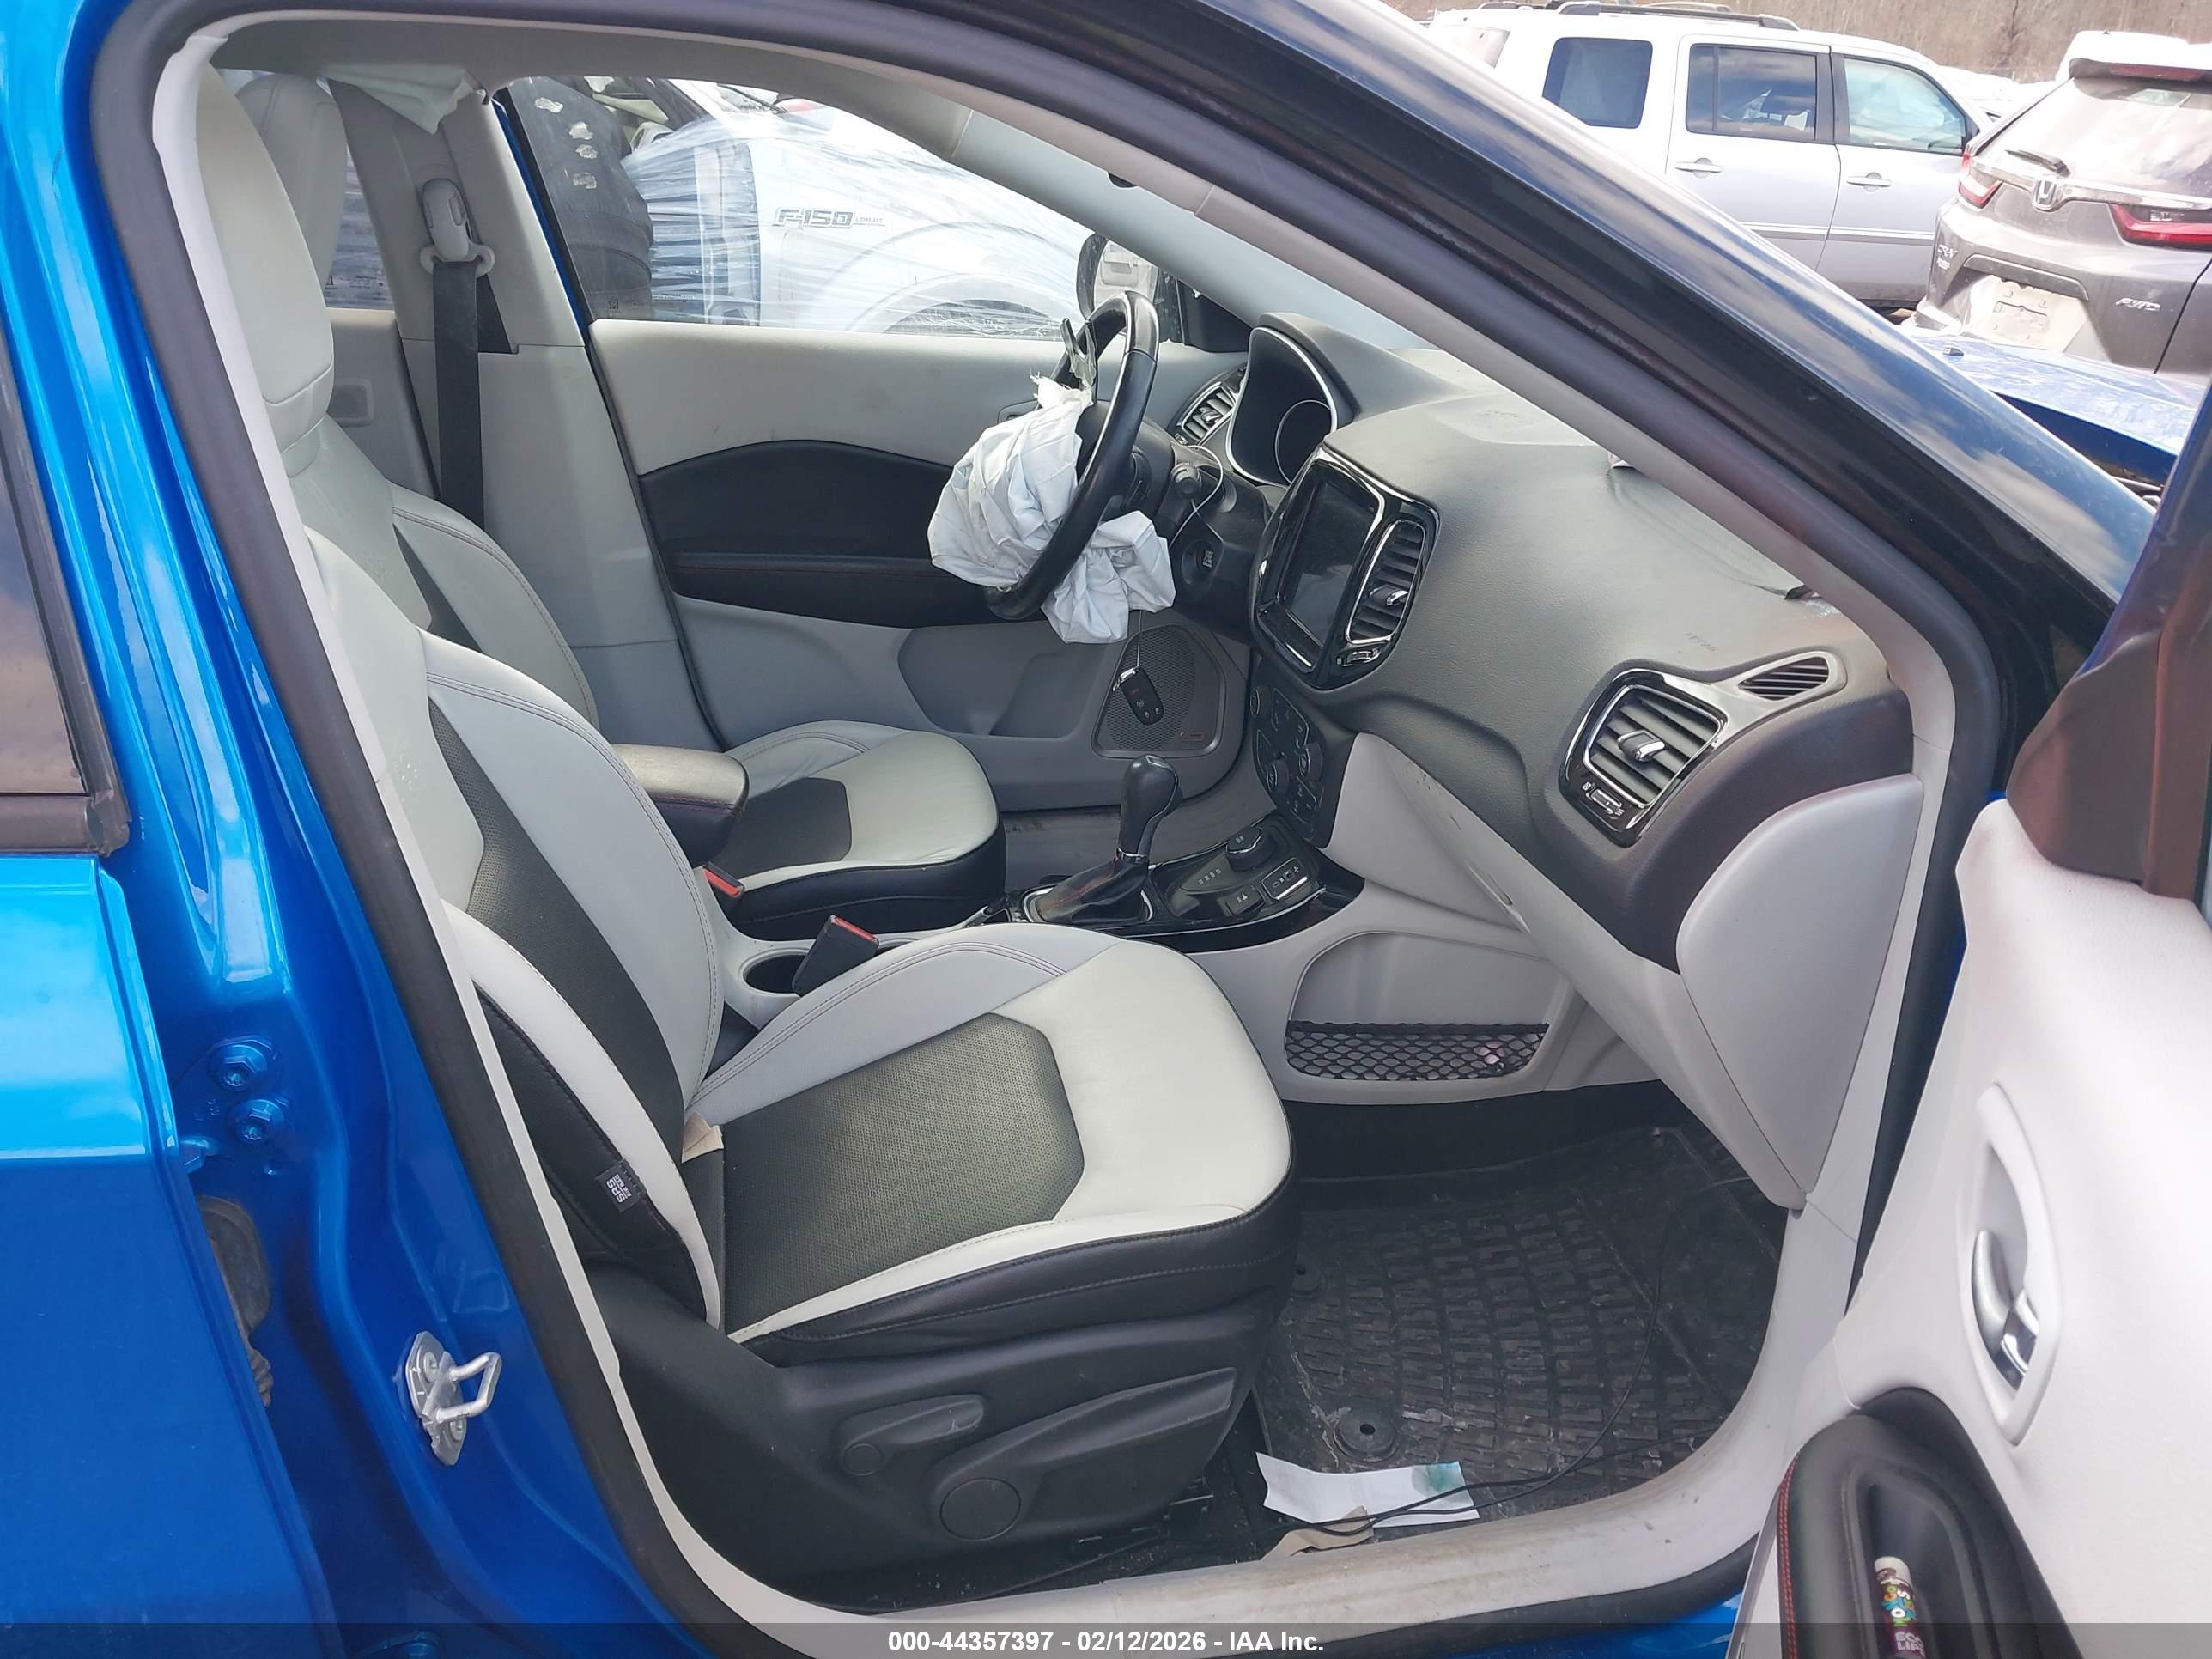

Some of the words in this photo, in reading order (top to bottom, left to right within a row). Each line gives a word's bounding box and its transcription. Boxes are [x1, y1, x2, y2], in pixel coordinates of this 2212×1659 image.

[775, 208, 854, 228] F-150
[2115, 297, 2161, 311] AWD
[614, 1174, 625, 1188] BAG
[606, 1178, 626, 1203] SRS
[623, 1187, 633, 1197] AIR
